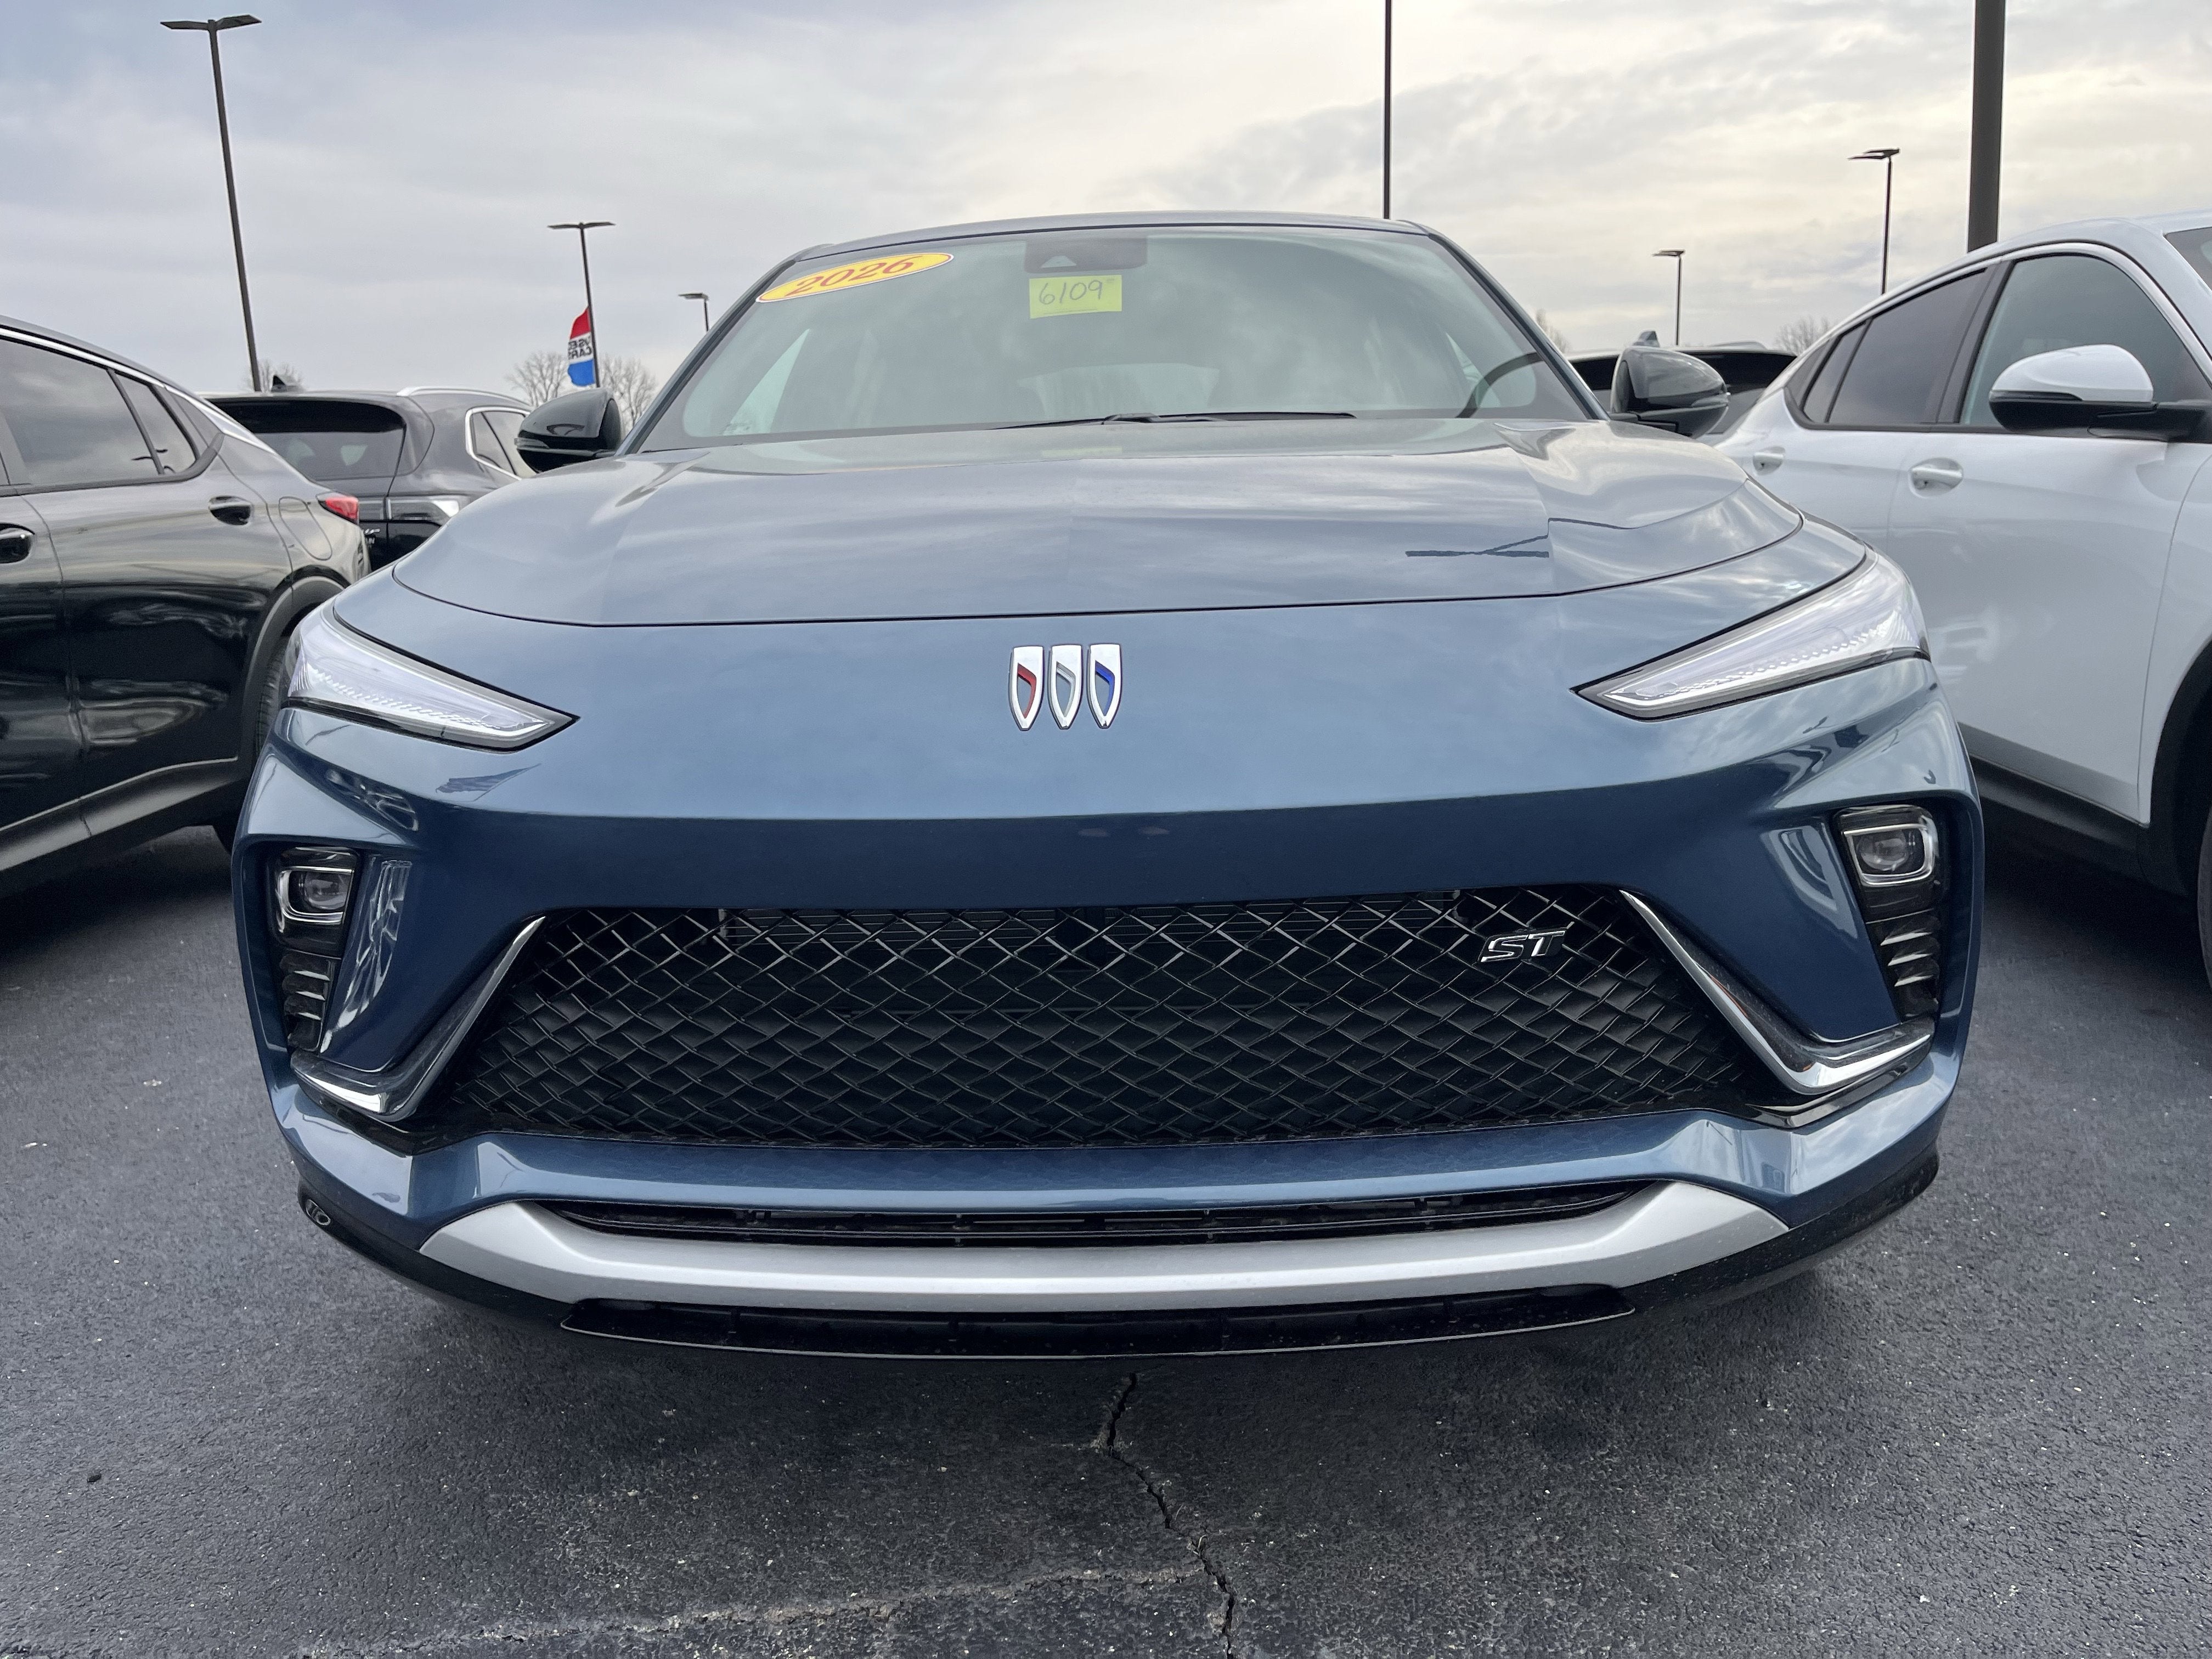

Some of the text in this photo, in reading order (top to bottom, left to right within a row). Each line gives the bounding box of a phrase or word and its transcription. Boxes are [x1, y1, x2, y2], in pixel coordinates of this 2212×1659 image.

[784, 256, 923, 297] 2026
[1039, 279, 1103, 305] 6109
[1481, 930, 1566, 962] ST
